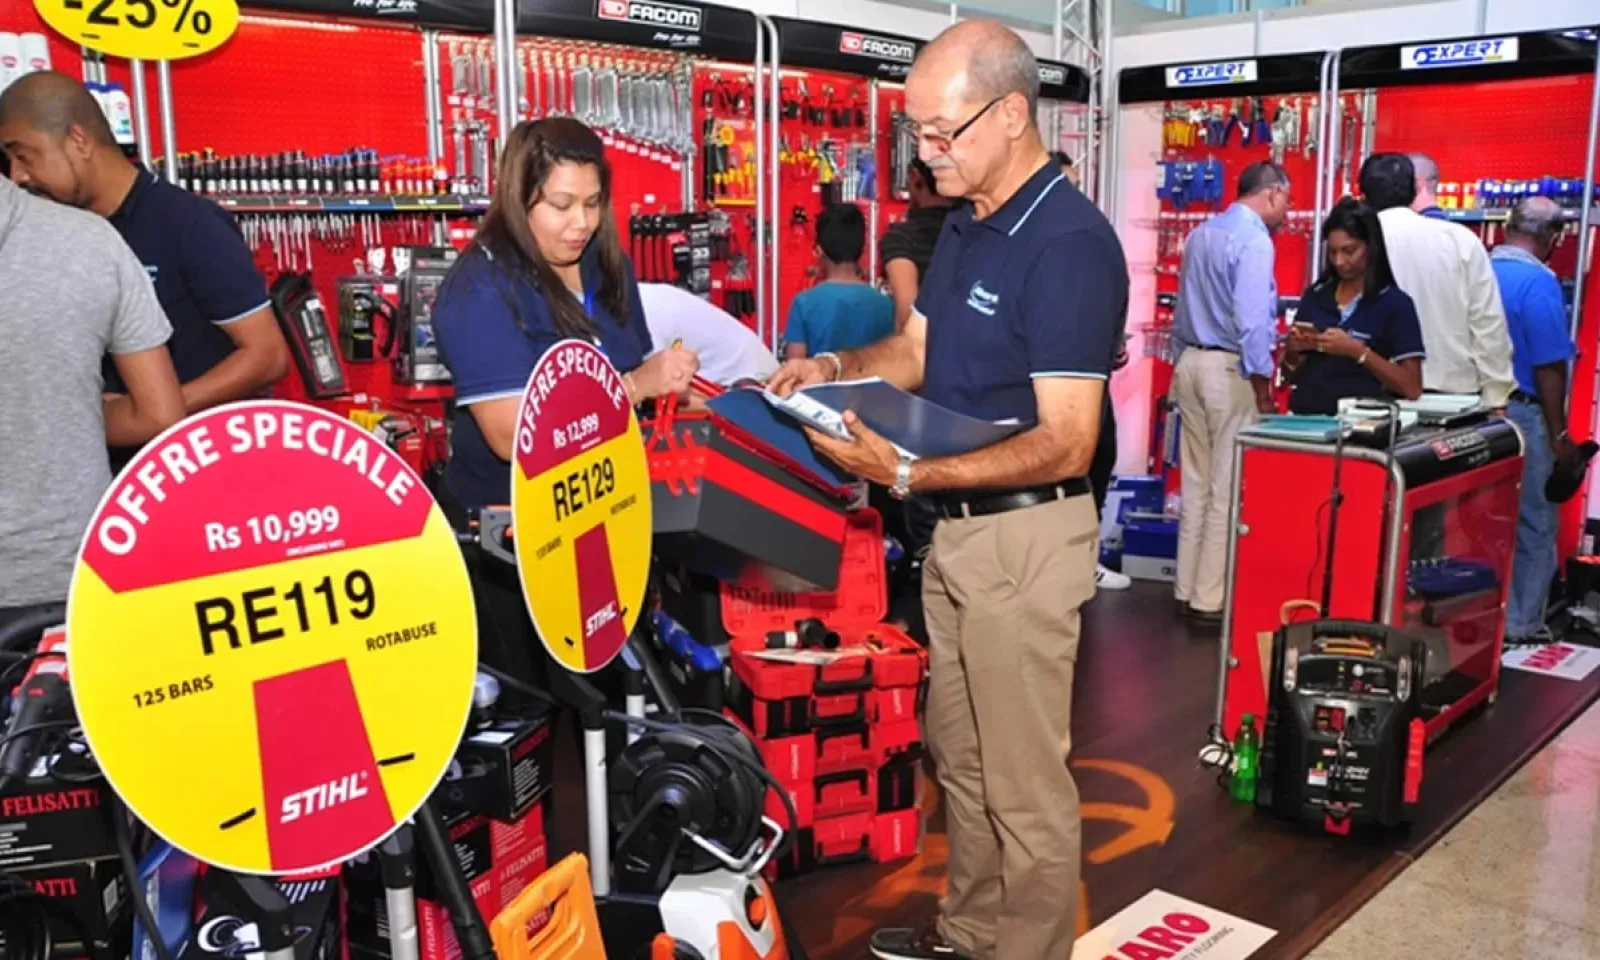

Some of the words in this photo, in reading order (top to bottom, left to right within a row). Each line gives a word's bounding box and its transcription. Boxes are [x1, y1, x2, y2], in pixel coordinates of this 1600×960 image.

[64, 0, 212, 35] -25%
[629, 4, 698, 26] FACOM
[863, 39, 912, 58] FACOM
[519, 360, 557, 454] OFFRE
[556, 347, 625, 411] SPECIALE
[552, 428, 567, 450] Rs
[567, 412, 599, 443] 12,999
[98, 428, 221, 556] OFFRE
[226, 412, 416, 506] SPECIALE
[552, 457, 616, 522] RE129
[204, 522, 242, 552] Rs
[246, 505, 340, 544] 10,999
[194, 569, 376, 655] RE119
[365, 622, 438, 652] ROTABUSE
[132, 686, 166, 709] 125
[168, 675, 215, 699] BARS
[3, 789, 99, 816] FELISATTI
[279, 774, 368, 825] STIHL
[1101, 912, 1211, 960] ARO
